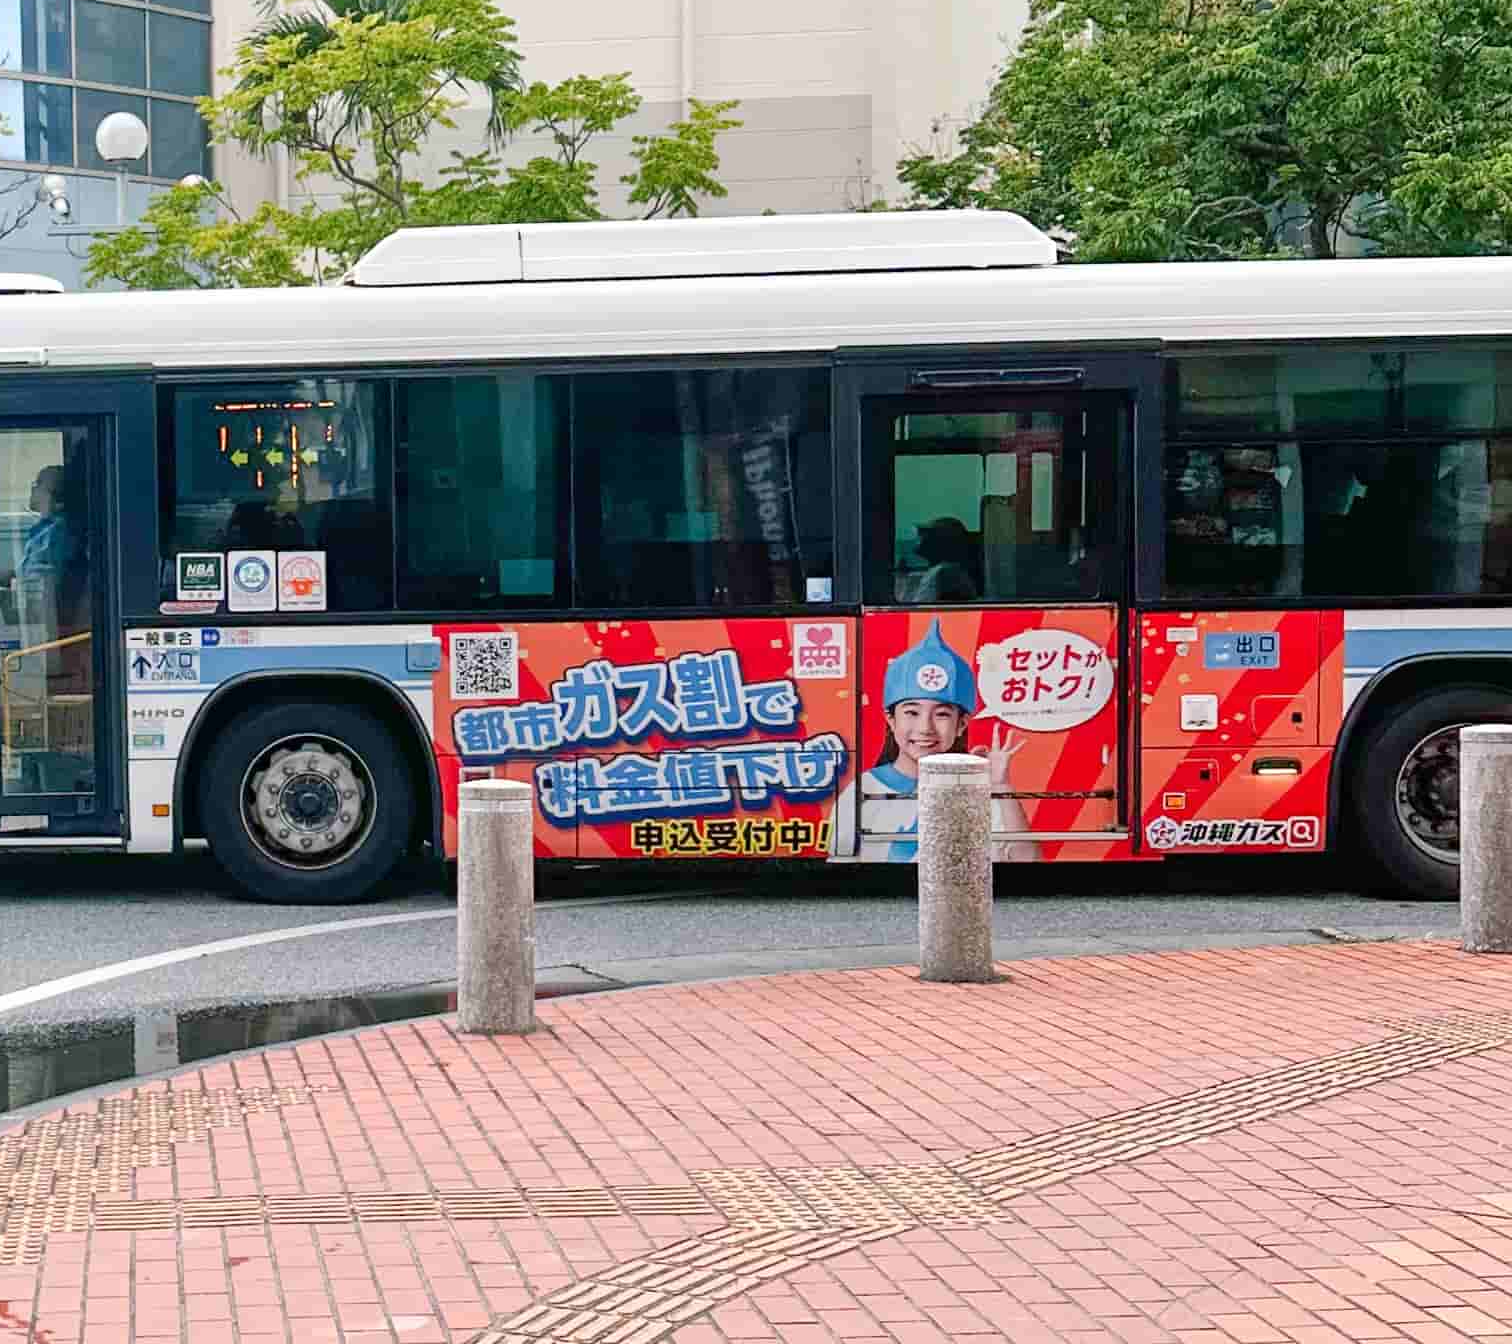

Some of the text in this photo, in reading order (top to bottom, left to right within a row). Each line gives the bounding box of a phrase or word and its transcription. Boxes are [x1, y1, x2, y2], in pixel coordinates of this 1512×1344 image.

[1006, 643, 1105, 672] セットが
[1237, 636, 1275, 653] 出口
[157, 652, 193, 668] 入口
[1240, 656, 1269, 665] EXIT
[1000, 675, 1096, 703] おトク!
[132, 708, 186, 718] HINO
[455, 650, 799, 758] 都市ガス割で
[538, 734, 845, 822] 料金値下げ
[633, 818, 831, 854] 申込受付中!
[1180, 819, 1286, 844] 沖縄ガス
